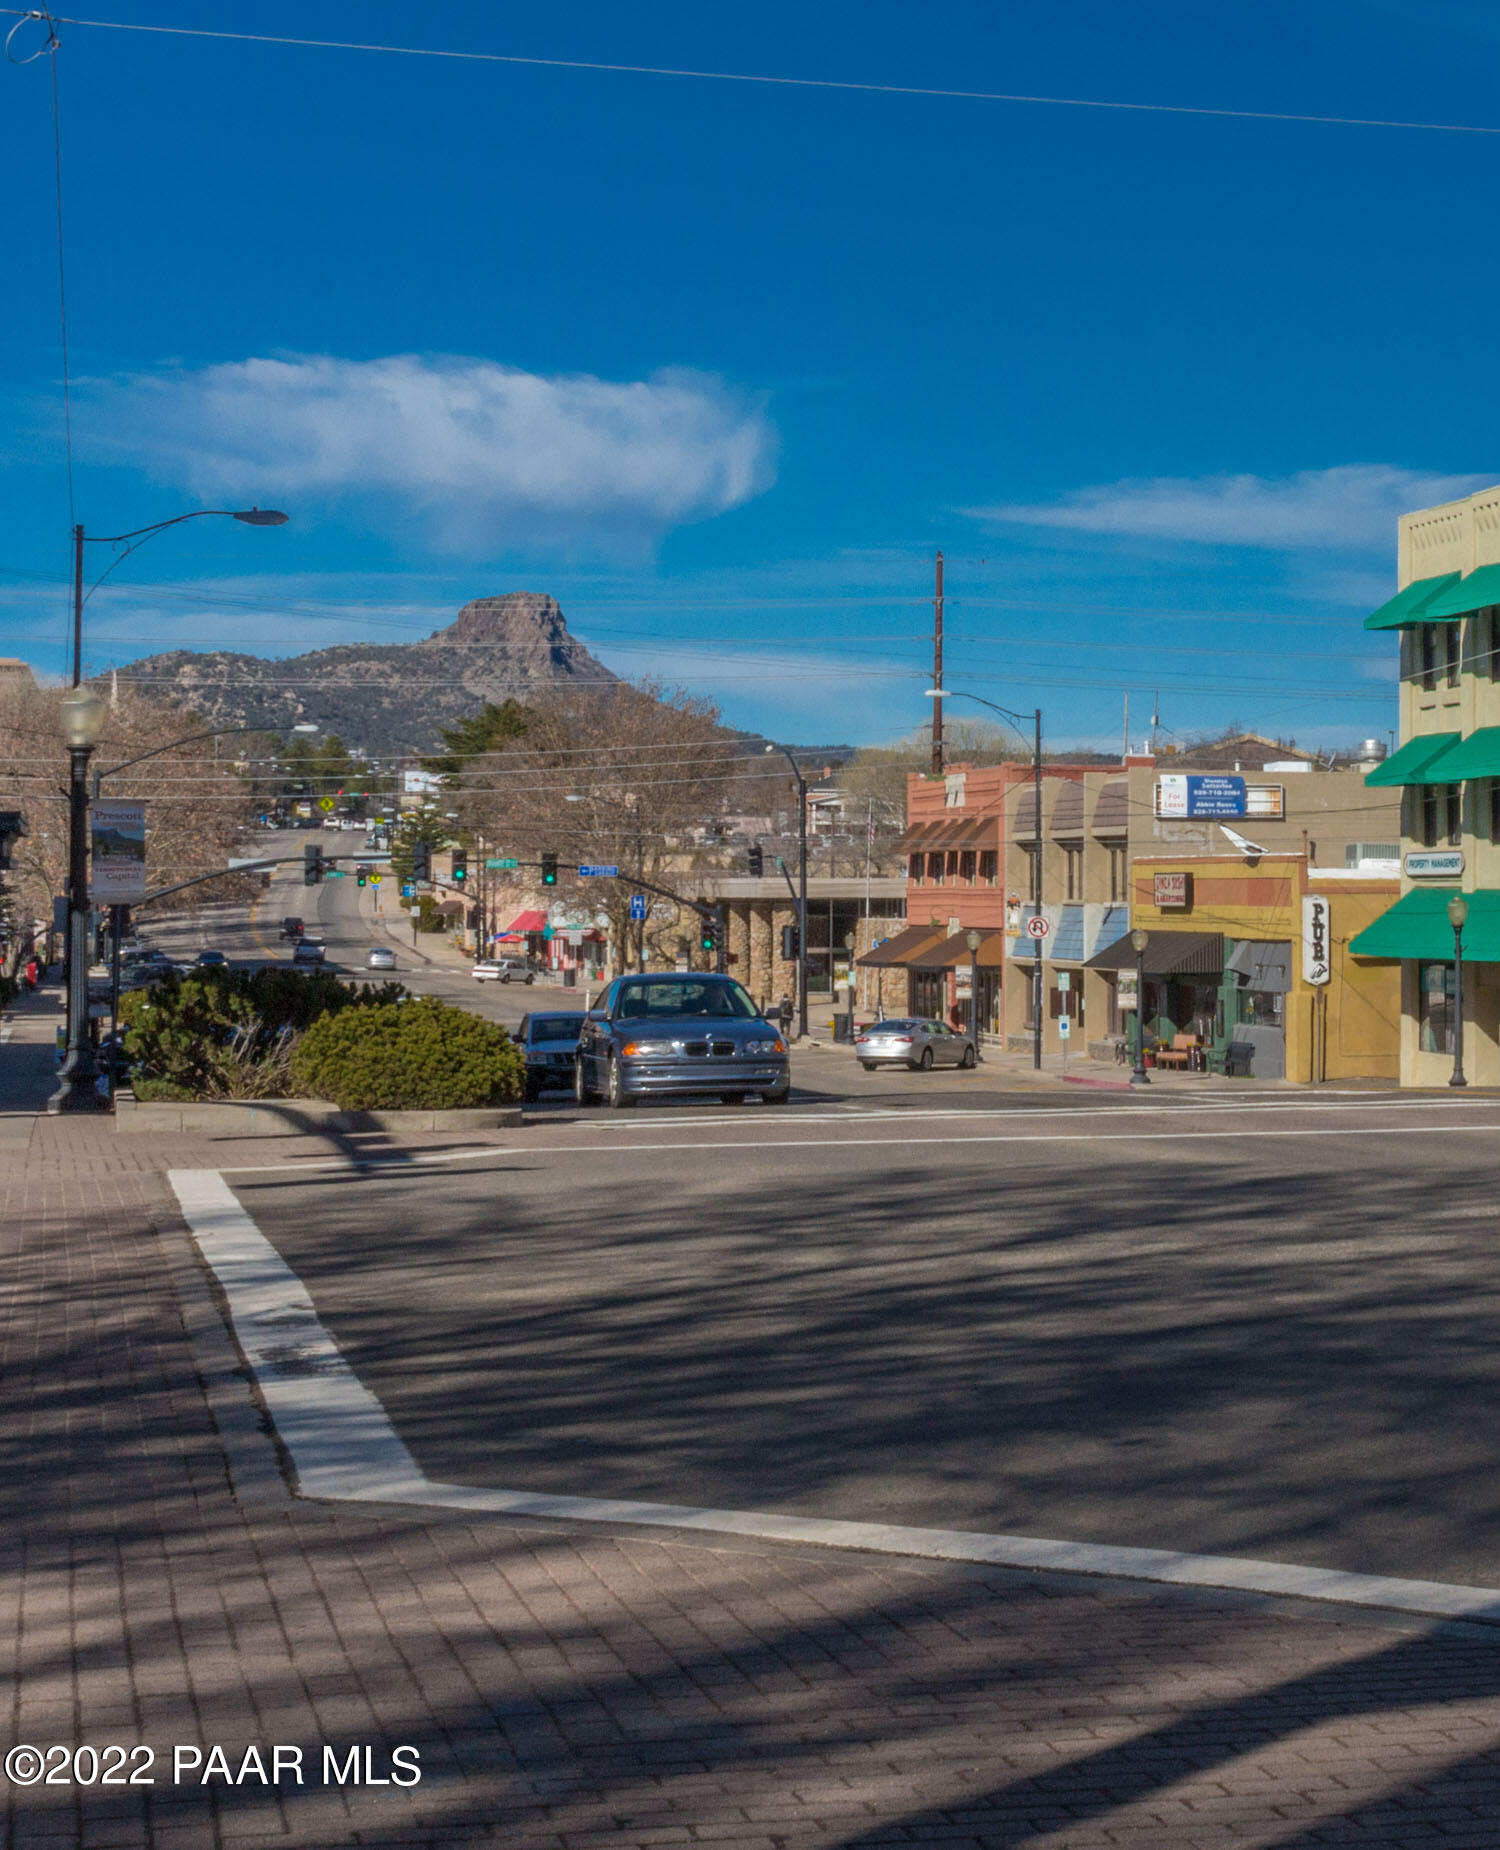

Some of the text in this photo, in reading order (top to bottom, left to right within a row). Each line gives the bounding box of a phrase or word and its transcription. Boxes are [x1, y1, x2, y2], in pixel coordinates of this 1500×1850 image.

[1163, 801, 1185, 809] Lease
[1408, 857, 1460, 869] PROPERTY MANAGEMENT
[632, 897, 643, 909] H
[1311, 902, 1326, 962] PUB
